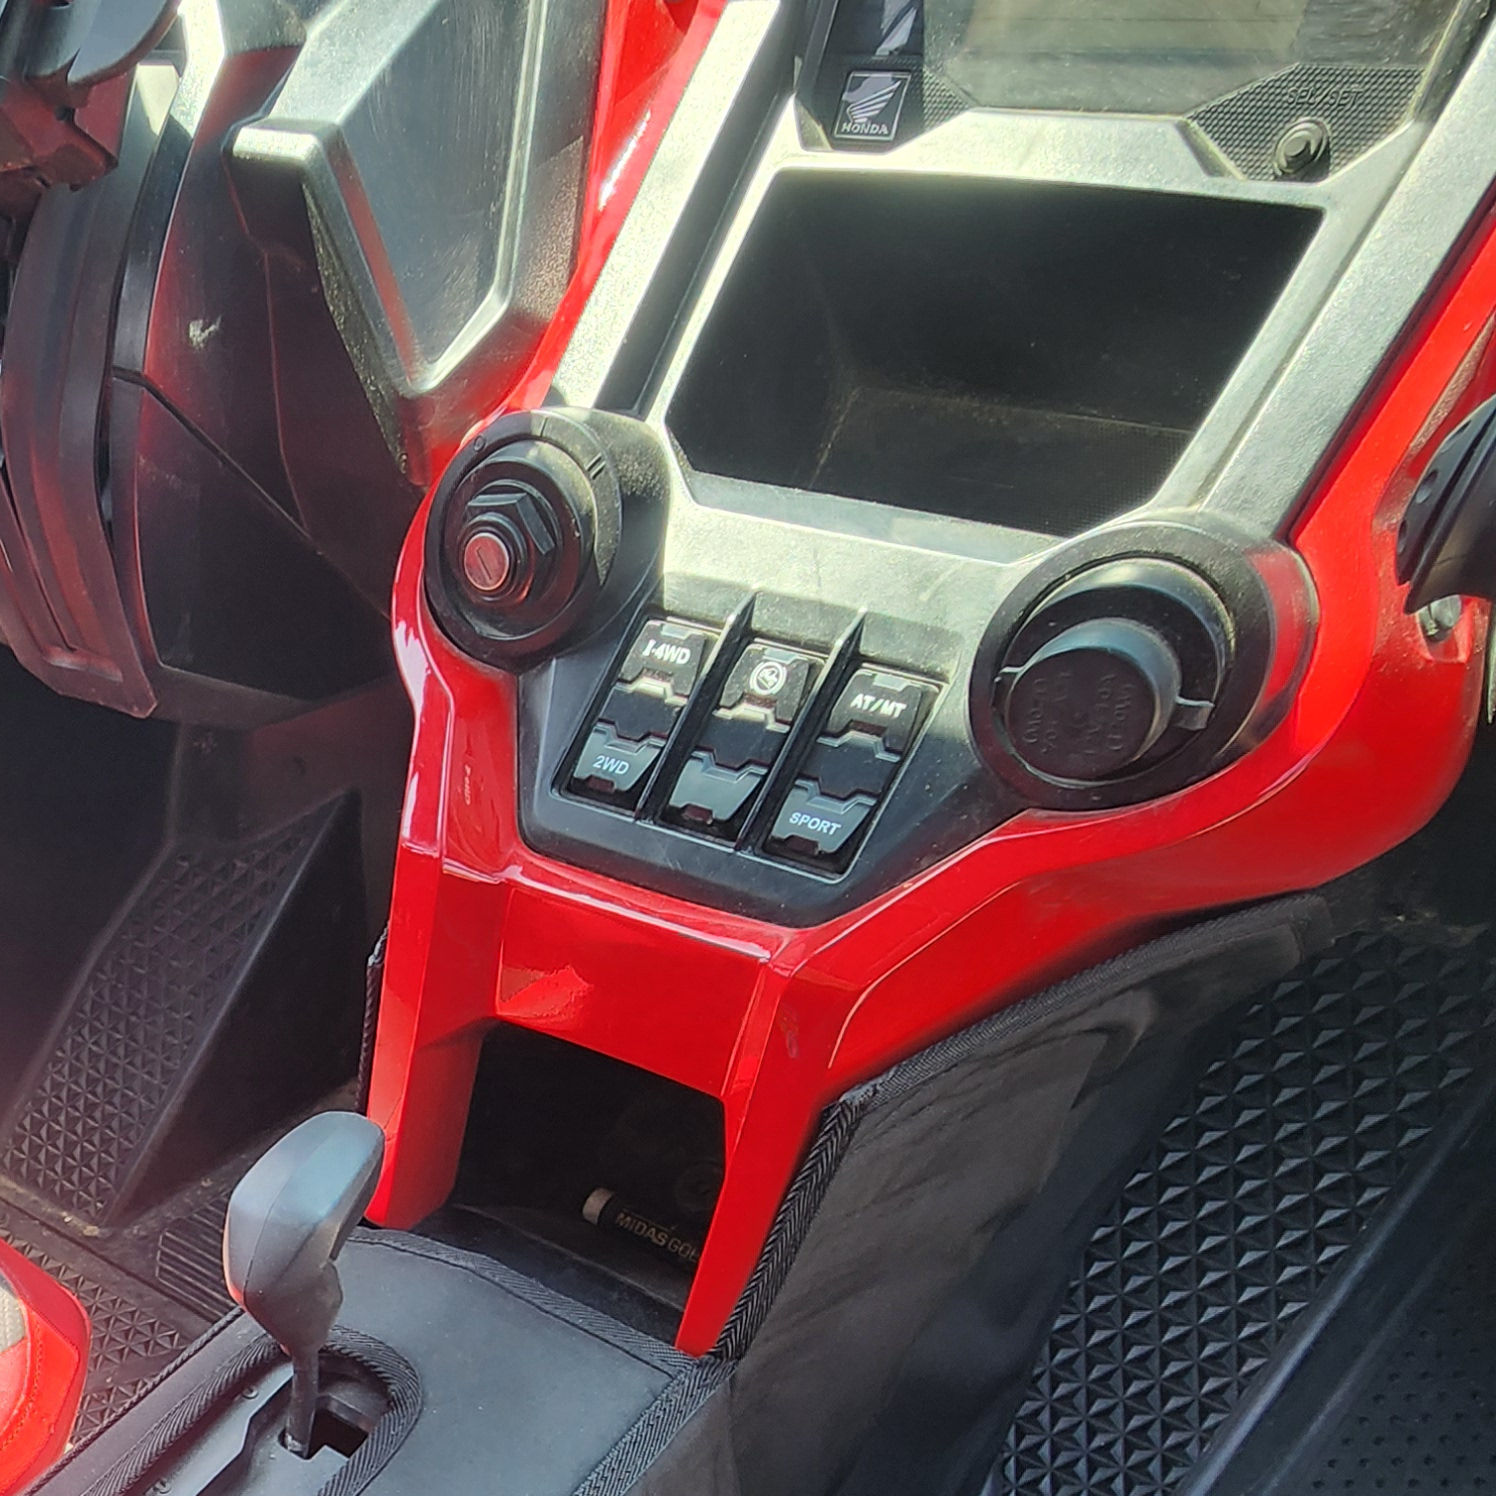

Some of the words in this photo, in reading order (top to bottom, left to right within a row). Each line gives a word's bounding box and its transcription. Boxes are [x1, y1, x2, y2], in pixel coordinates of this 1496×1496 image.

[841, 122, 889, 134] HONDA
[642, 640, 692, 665] I-4WD
[850, 693, 906, 718] AT/MT
[592, 755, 630, 776] 2WD
[789, 811, 841, 836] SPORT
[616, 1212, 668, 1247] MIDAS
[667, 1237, 701, 1264] GOL
